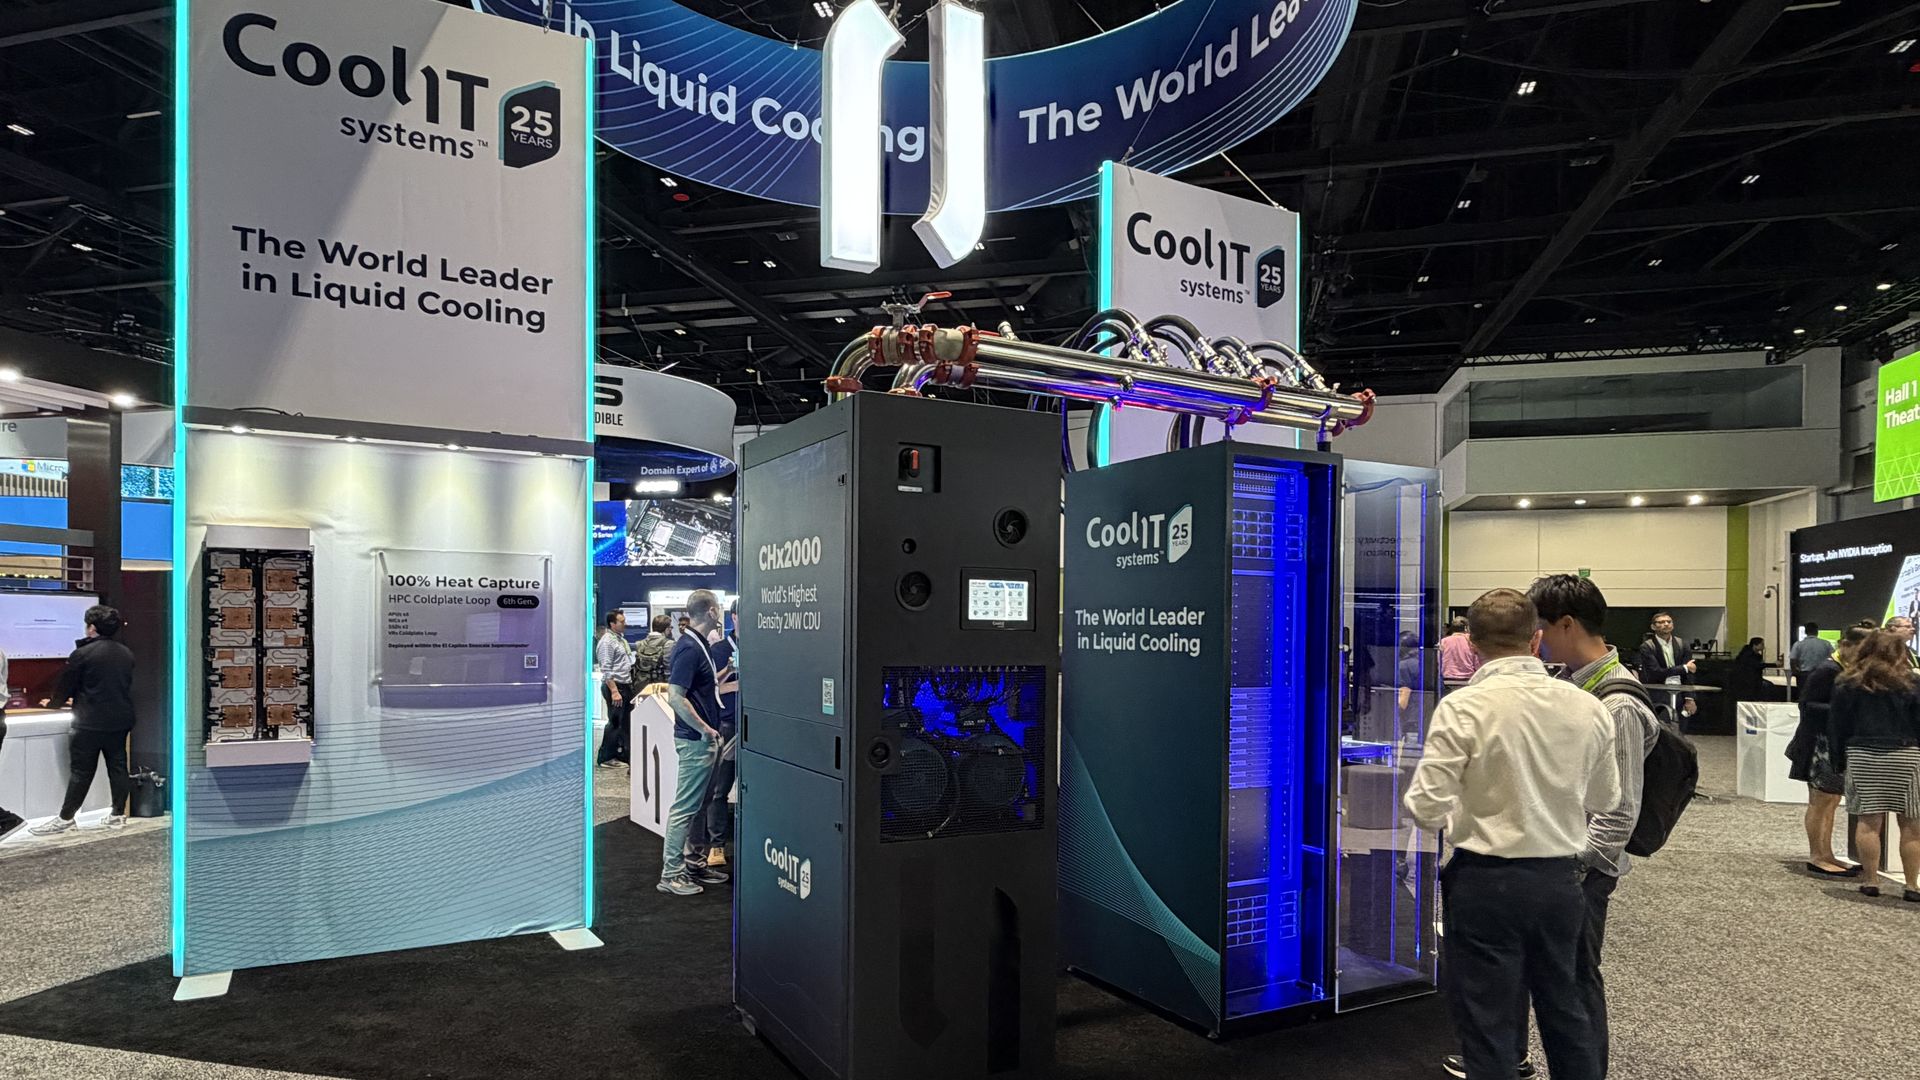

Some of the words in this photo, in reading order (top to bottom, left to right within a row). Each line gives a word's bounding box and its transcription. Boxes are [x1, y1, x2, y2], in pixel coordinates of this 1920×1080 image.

[222, 12, 490, 132] CoolIT
[610, 29, 737, 125] Liquid
[1019, 101, 1102, 145] The
[1115, 28, 1237, 120] World
[1250, 0, 1310, 59] Lea
[510, 104, 553, 138] 25
[511, 131, 553, 150] YEARS
[231, 225, 306, 260] The
[318, 238, 428, 279] World
[439, 257, 554, 296] Leader
[1126, 212, 1251, 284] CoolIT
[1260, 263, 1282, 286] 25
[1260, 281, 1282, 294] YEARS
[242, 263, 277, 294] in
[291, 272, 406, 311] Liquid
[417, 290, 546, 334] Cooling
[1884, 381, 1911, 408] Hall
[1911, 379, 1918, 398] 1
[640, 466, 675, 476] Domain
[676, 464, 701, 477] Expert
[701, 462, 708, 472] of
[1086, 510, 1166, 550] CoolIT
[1172, 523, 1189, 541] 25
[758, 535, 822, 572] CHx2000
[1838, 546, 1861, 559] NVIDIA
[1860, 542, 1893, 556] Inception
[387, 574, 431, 588] 100%
[435, 575, 474, 588] Heat
[478, 576, 541, 591] Capture
[760, 585, 788, 604] World's
[787, 583, 818, 608] Highest
[387, 593, 412, 604] HPC
[413, 594, 464, 606] Coldplate
[465, 595, 492, 606] Loop
[502, 596, 516, 605] 6th
[757, 611, 784, 634] Density
[783, 611, 803, 630] 2MW
[802, 611, 821, 631] CDU
[1075, 608, 1100, 627] The
[1102, 607, 1146, 626] World
[1149, 606, 1205, 626] Leader
[1077, 631, 1090, 650] in
[1093, 632, 1137, 654] Liquid
[1139, 632, 1201, 658] Cooling
[764, 837, 800, 883] CoolIT
[801, 870, 810, 884] 25
